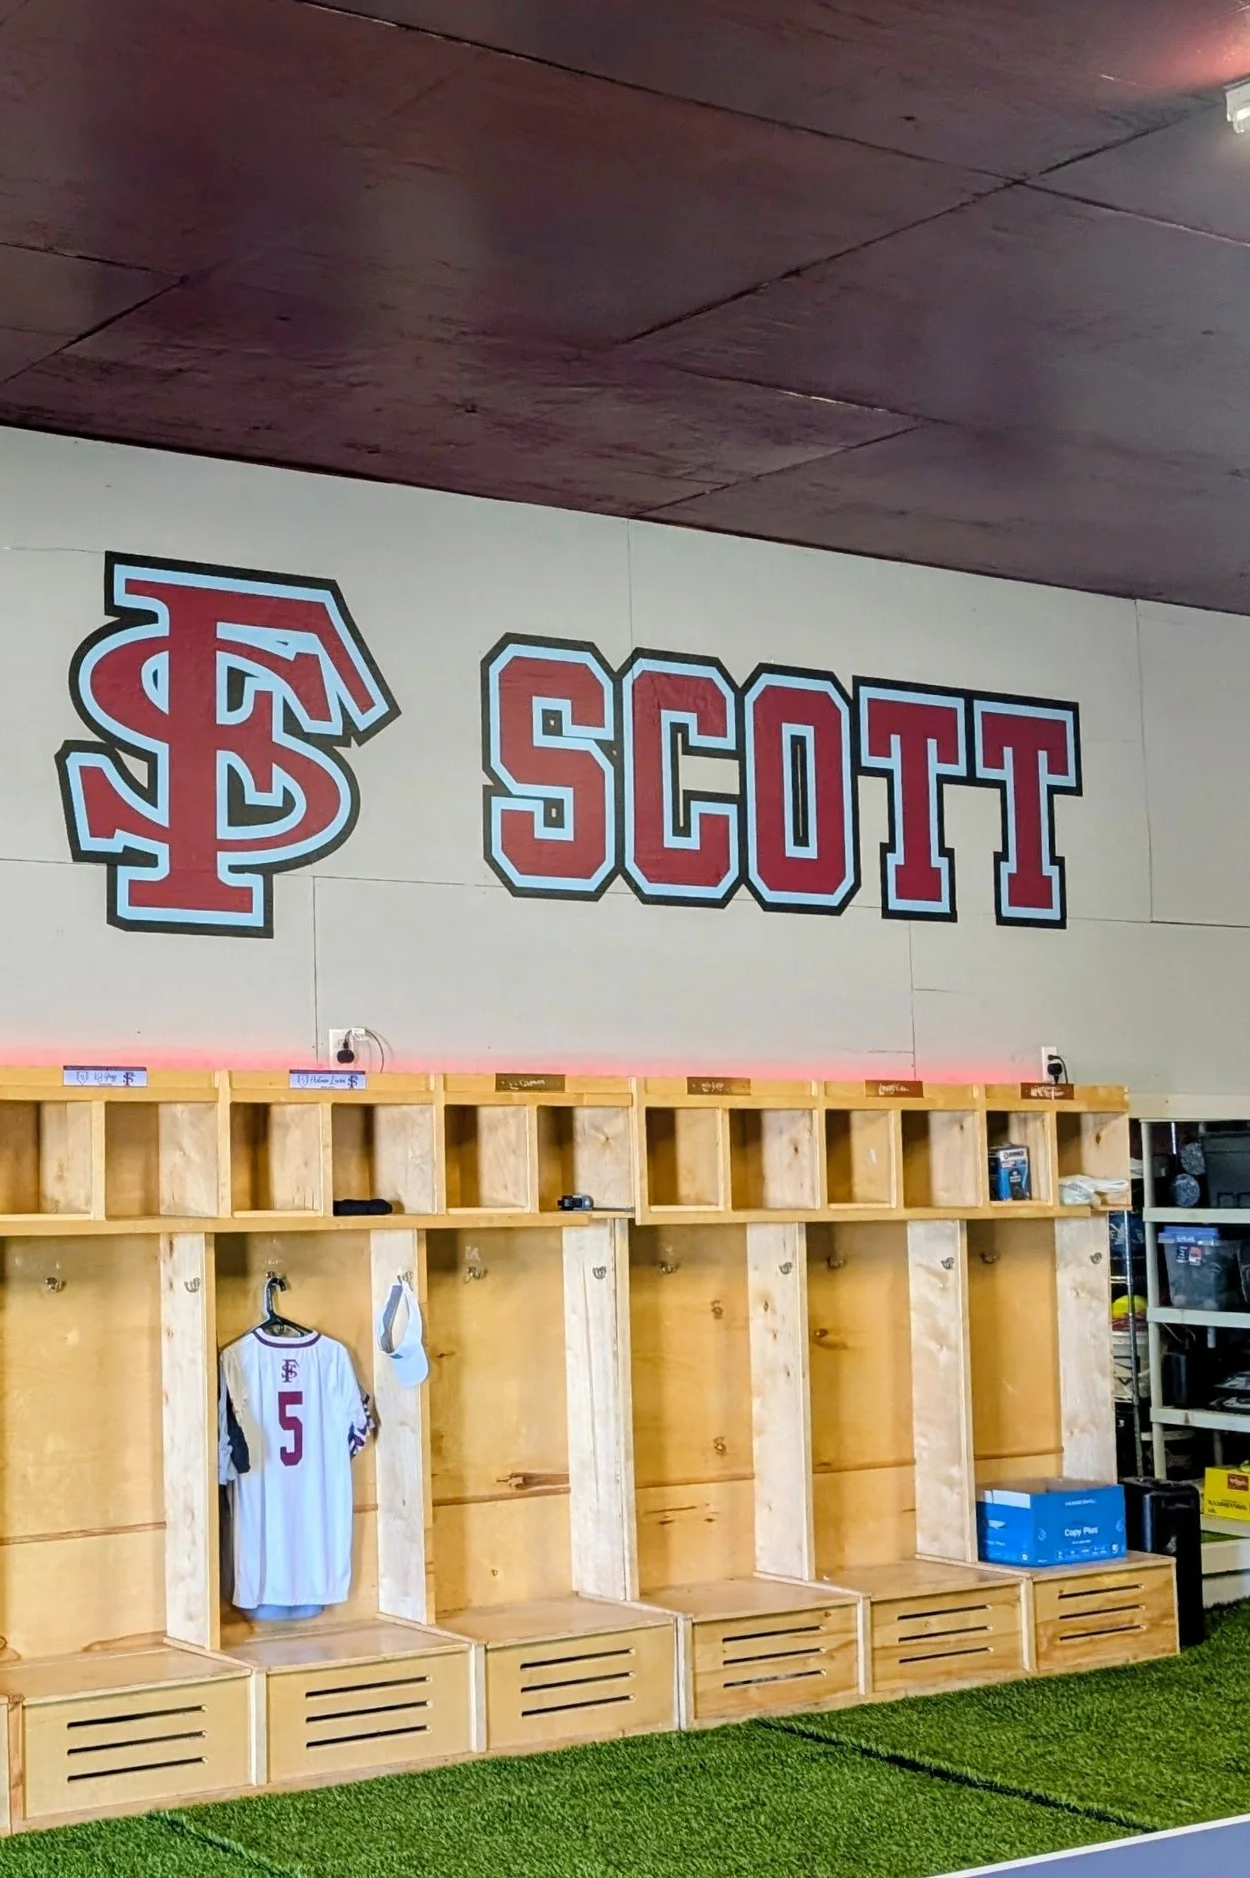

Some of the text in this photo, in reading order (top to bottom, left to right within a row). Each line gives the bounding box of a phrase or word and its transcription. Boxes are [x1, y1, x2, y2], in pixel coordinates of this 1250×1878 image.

[482, 632, 1082, 929] SCOTT
[278, 1391, 303, 1466] 5
[1064, 1529, 1082, 1537] Copy
